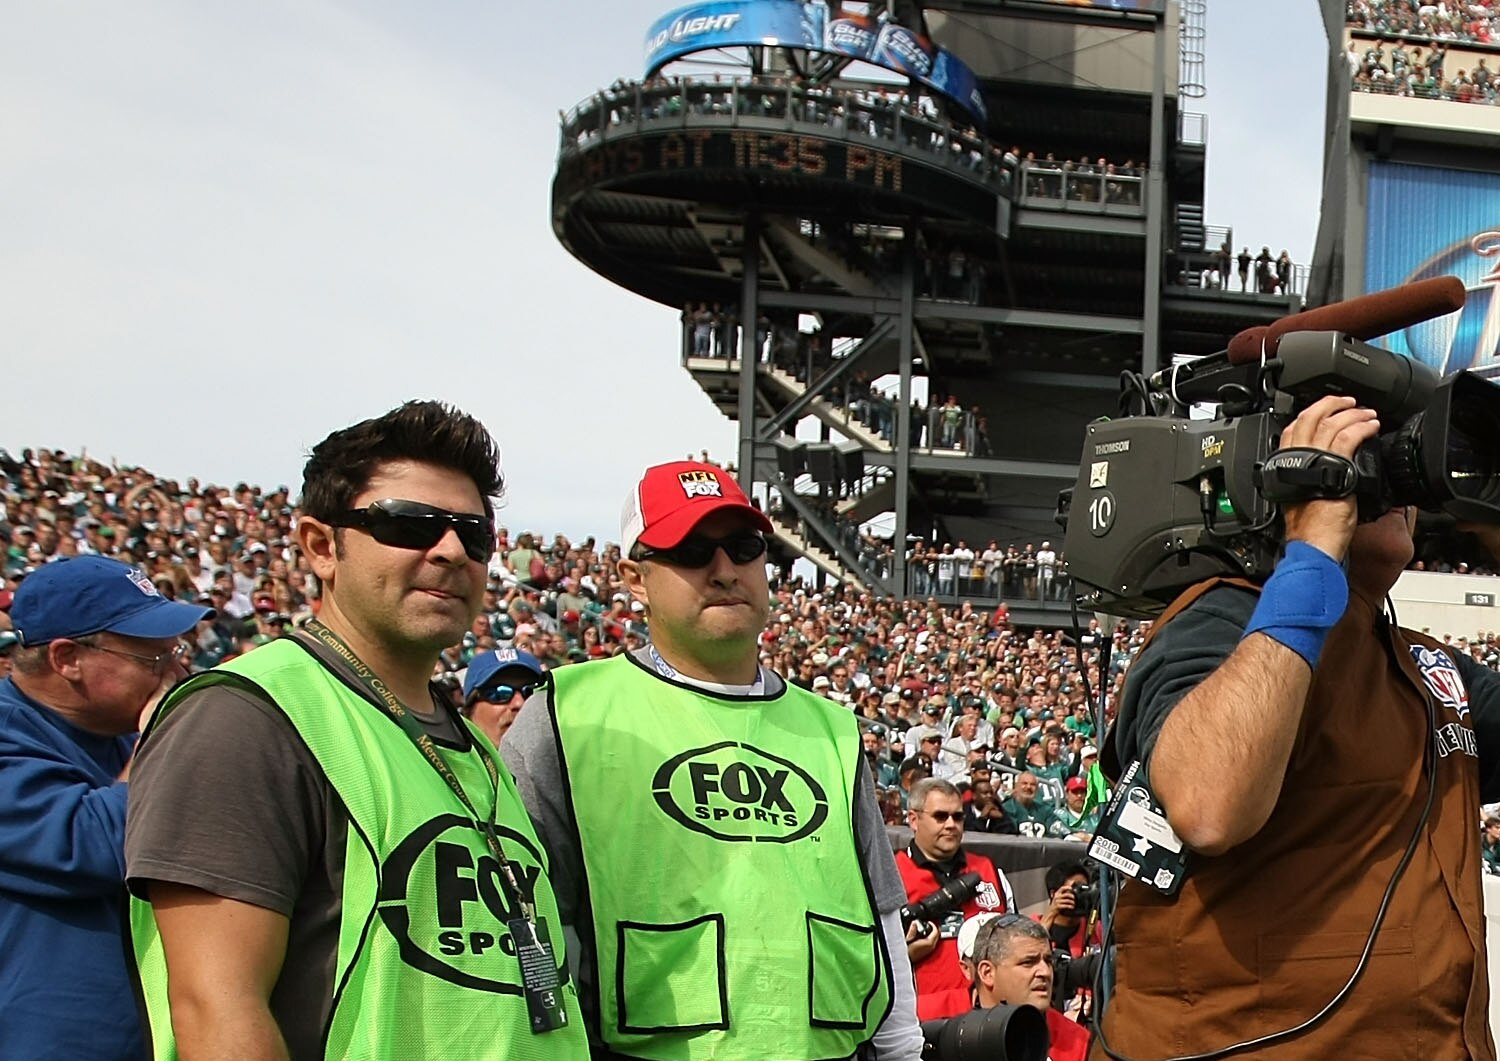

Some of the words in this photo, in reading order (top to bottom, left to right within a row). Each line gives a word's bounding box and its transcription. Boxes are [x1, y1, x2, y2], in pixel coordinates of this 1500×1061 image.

[674, 13, 740, 37] LIGHT
[661, 129, 712, 168] AT
[846, 145, 902, 192] PM
[1095, 440, 1130, 456] THOMSON
[1201, 435, 1216, 450] HD
[680, 472, 717, 483] NFL
[682, 482, 723, 499] FOX
[1089, 496, 1112, 530] 10
[318, 627, 372, 678] Community
[371, 678, 406, 717] College
[416, 733, 448, 773] Mercer
[688, 761, 797, 813] FOX
[694, 806, 799, 828] SPORTS
[1095, 836, 1119, 854] 2010
[435, 841, 542, 928] FOX
